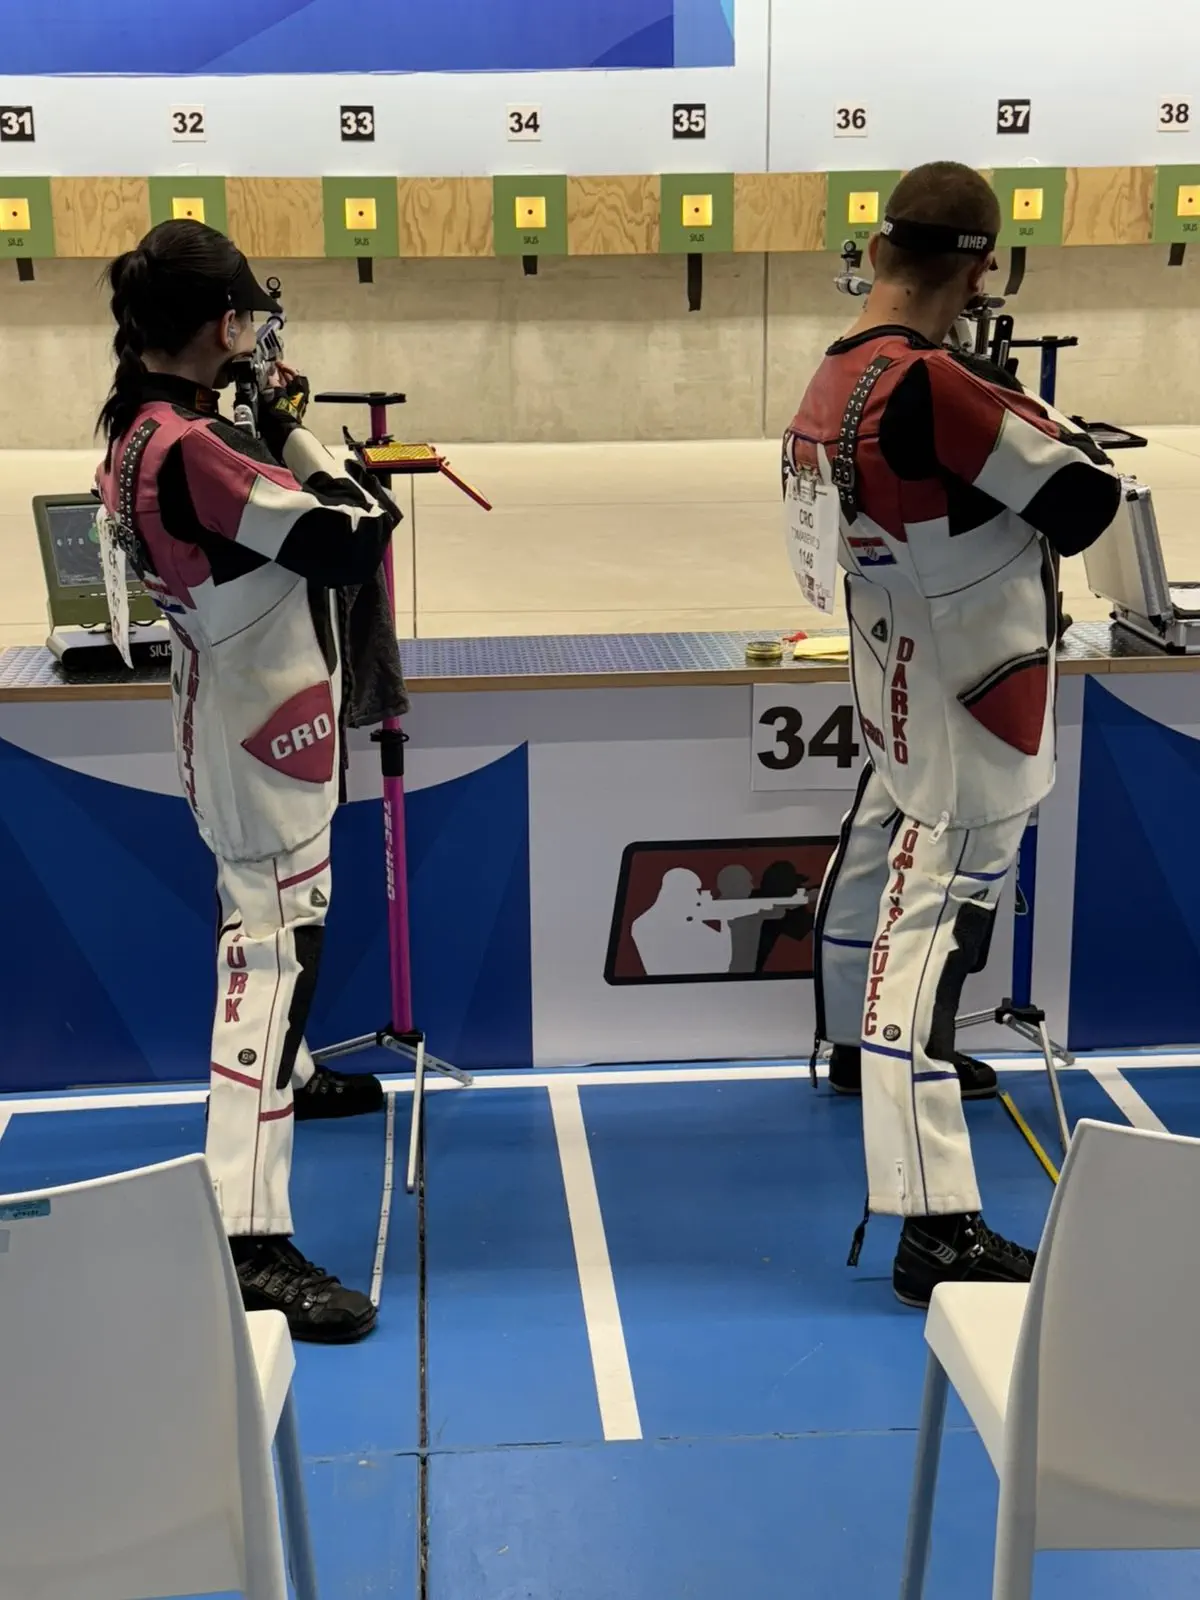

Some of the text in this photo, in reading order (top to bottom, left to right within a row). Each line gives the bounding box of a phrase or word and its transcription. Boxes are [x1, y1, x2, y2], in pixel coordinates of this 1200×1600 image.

[1, 112, 32, 135] 31
[173, 112, 204, 133] 32
[342, 112, 373, 134] 33
[509, 112, 540, 132] 34
[674, 110, 704, 131] 35
[836, 108, 866, 129] 36
[998, 104, 1030, 127] 37
[1160, 103, 1189, 124] 38
[890, 636, 915, 765] DARKO
[270, 713, 333, 760] CRO
[756, 705, 860, 770] 34
